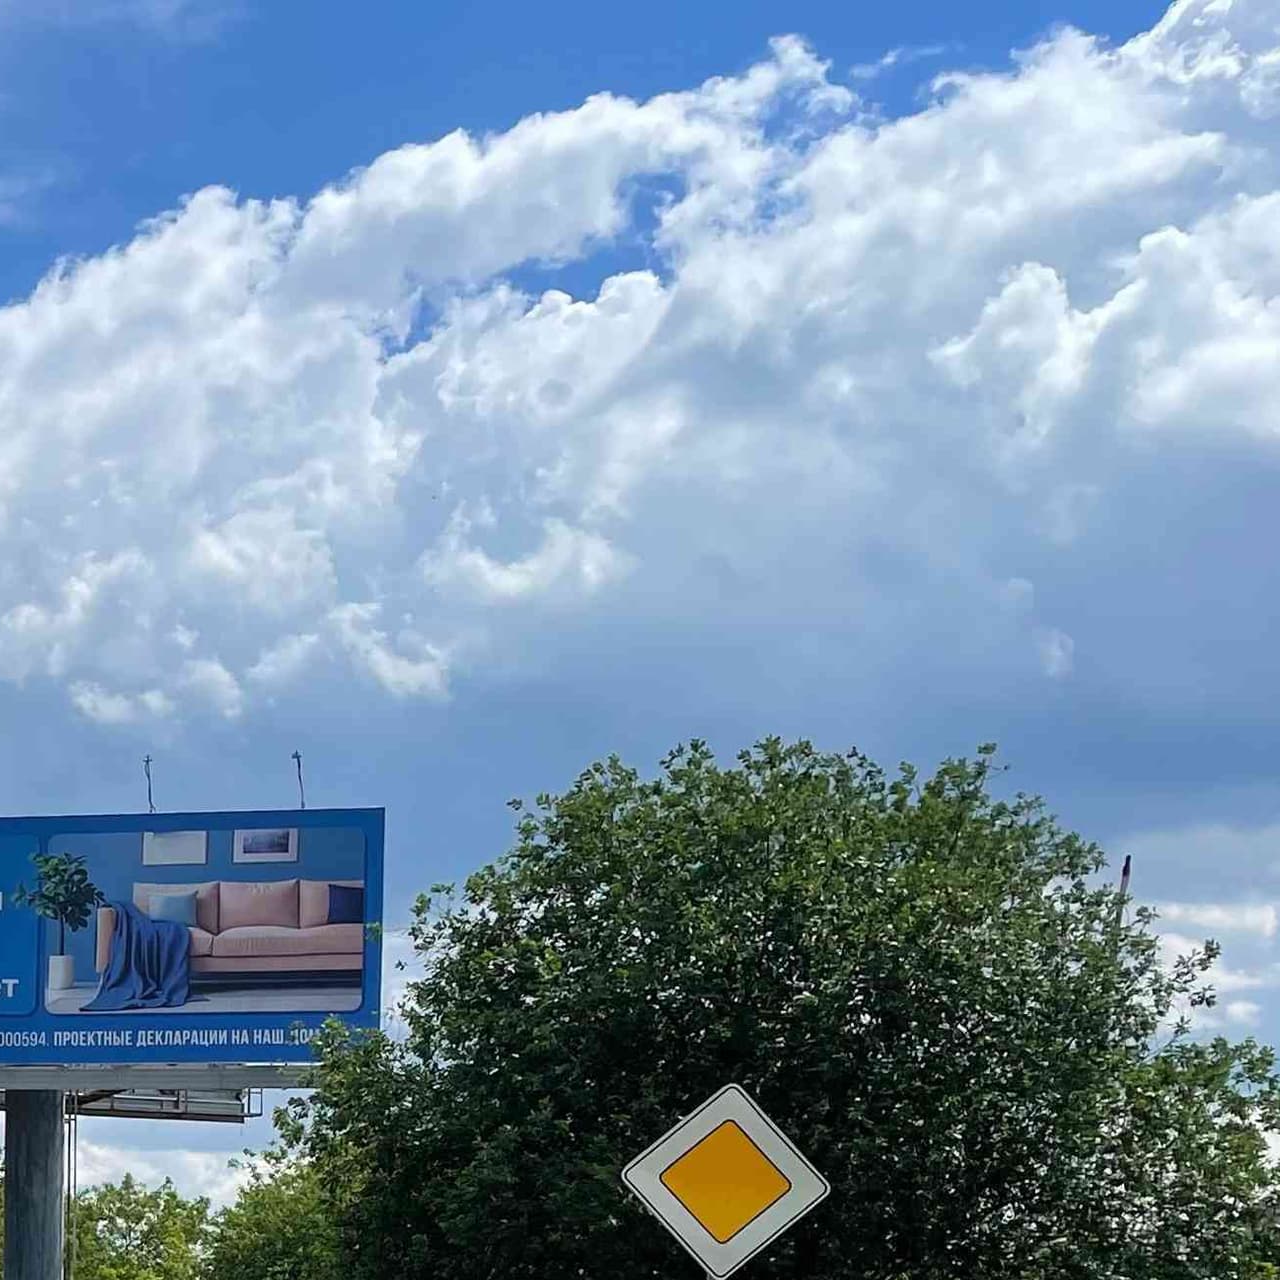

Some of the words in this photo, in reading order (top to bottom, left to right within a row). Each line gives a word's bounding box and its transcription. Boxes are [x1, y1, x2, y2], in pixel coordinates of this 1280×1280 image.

[54, 1030, 133, 1047] ПРОЕКТНЫЕ
[136, 1030, 228, 1048] ДЕКЛАРАЦИИ
[231, 1029, 249, 1045] НА
